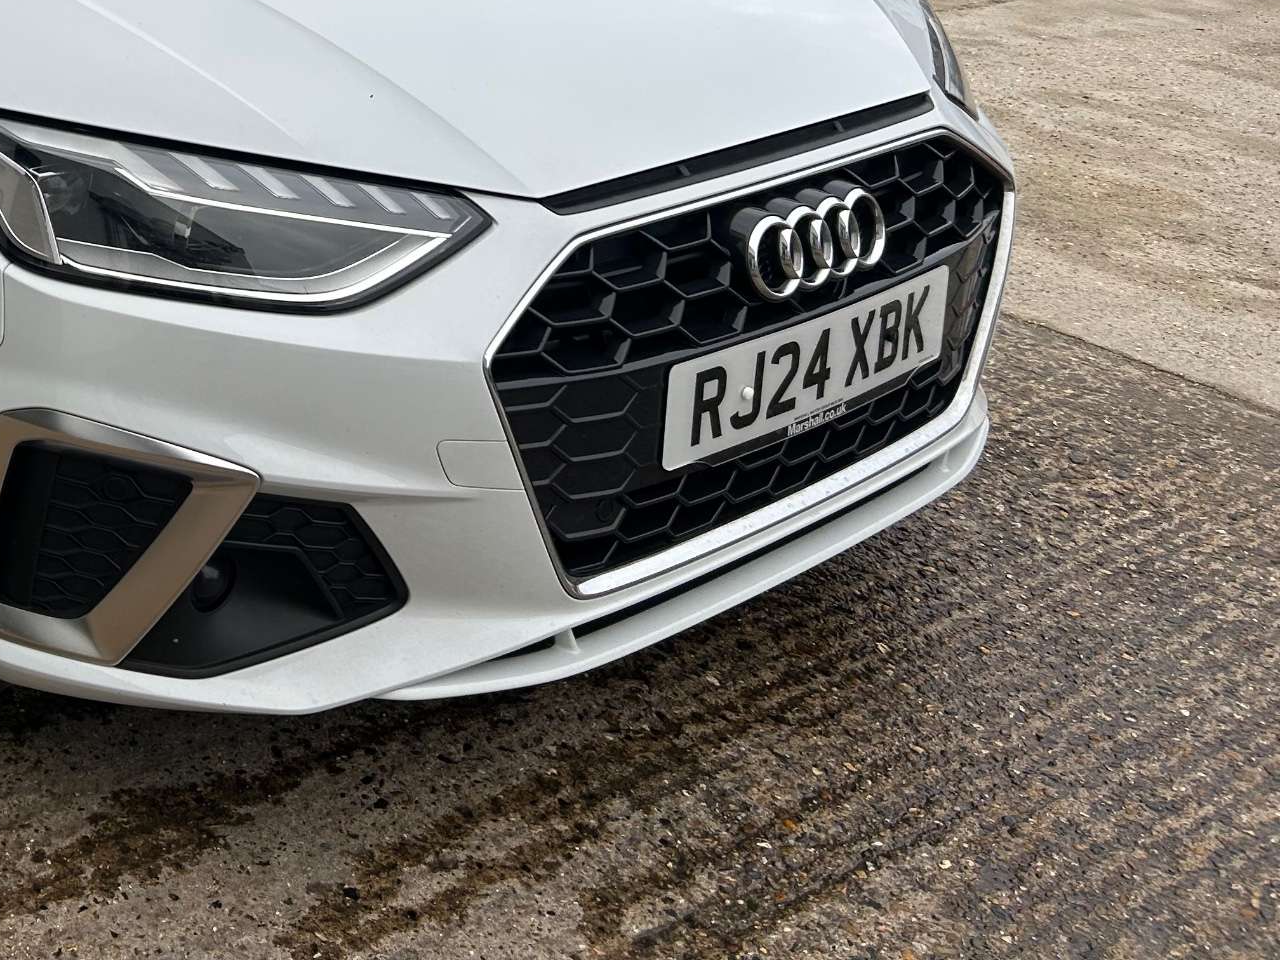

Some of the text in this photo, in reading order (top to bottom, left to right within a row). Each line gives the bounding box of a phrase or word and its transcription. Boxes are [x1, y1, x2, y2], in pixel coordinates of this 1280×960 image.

[690, 284, 931, 447] RJ24 XBK
[787, 401, 848, 437] Marshall.co.uk
